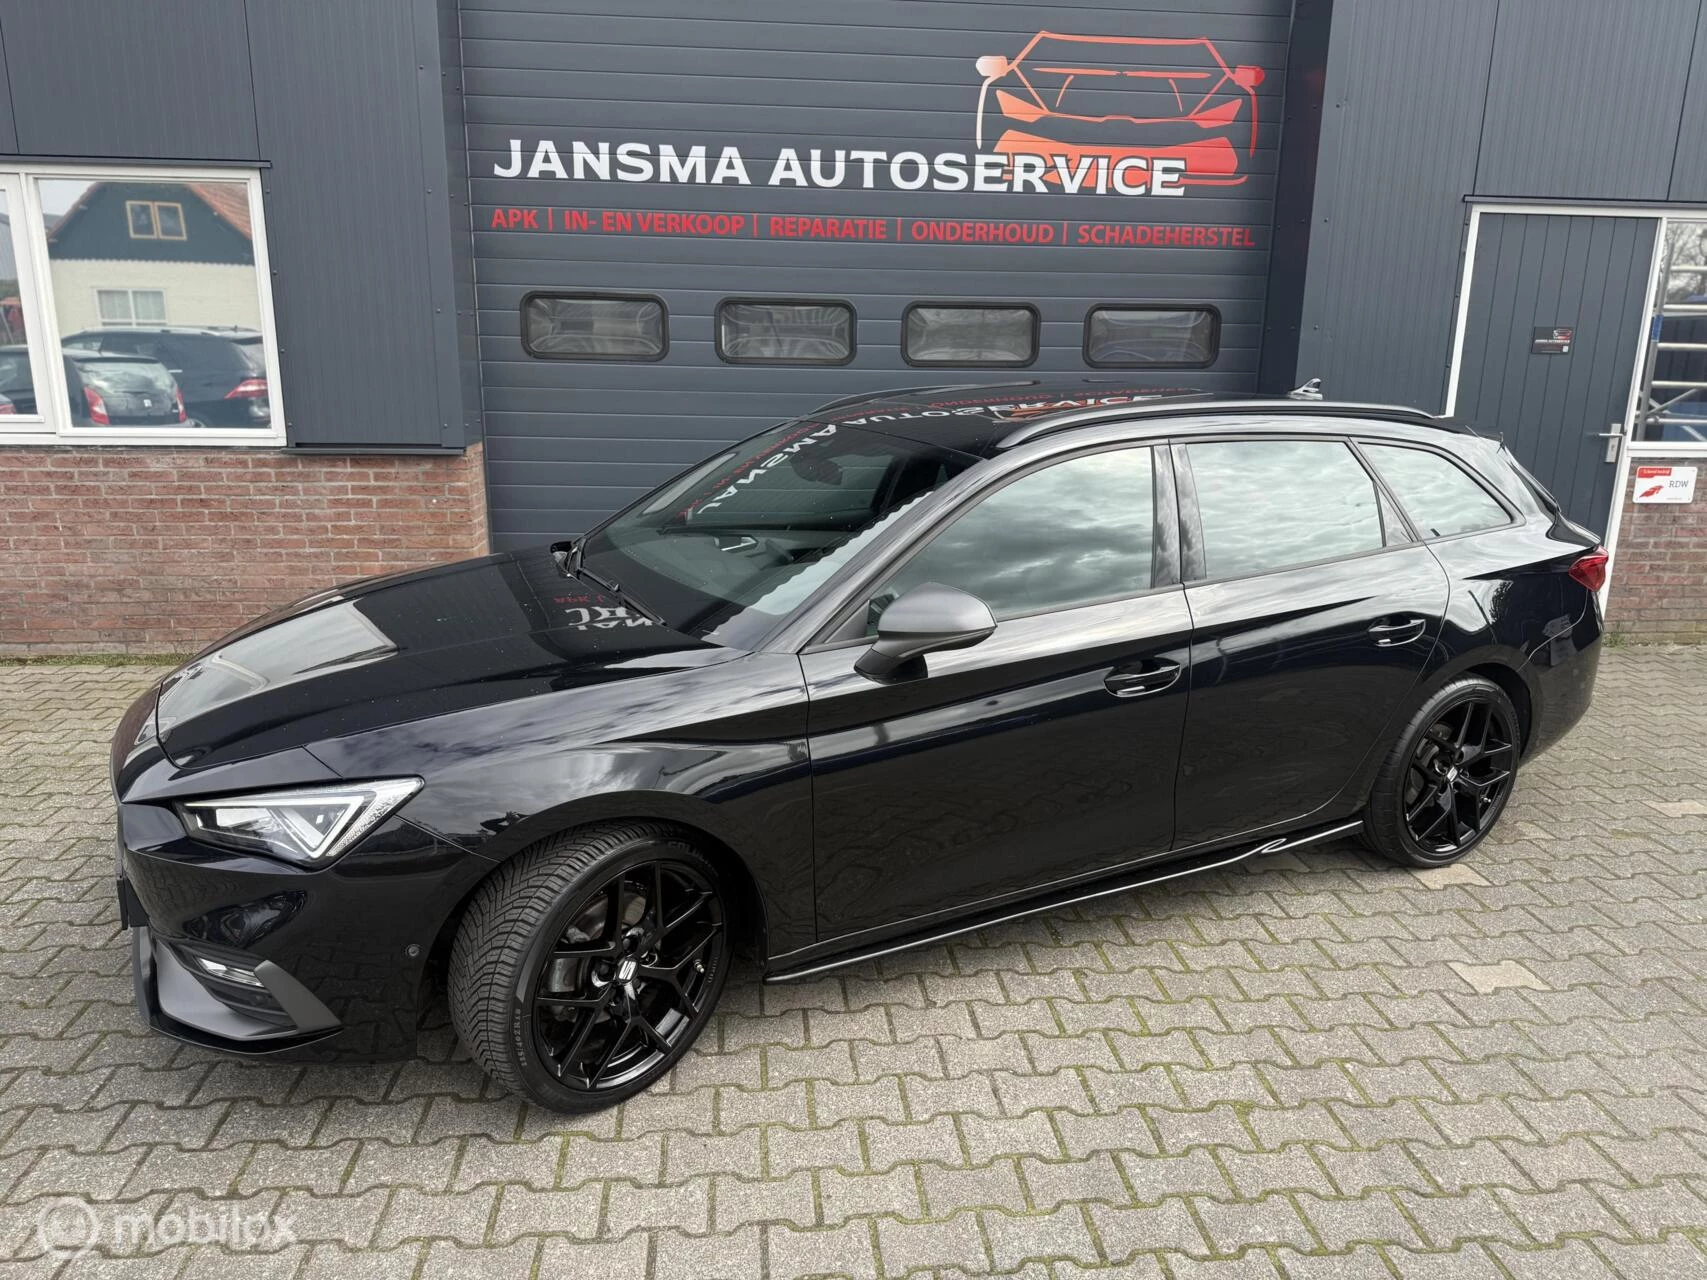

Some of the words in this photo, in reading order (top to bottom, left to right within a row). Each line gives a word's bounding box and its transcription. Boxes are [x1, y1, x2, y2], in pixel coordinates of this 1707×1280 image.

[493, 139, 752, 185] JANSMA
[768, 148, 1186, 196] AUTOSERVICE
[491, 208, 539, 229] APK
[564, 210, 596, 231] IN-
[602, 211, 632, 232] EN
[637, 212, 745, 235] VERKOOP
[769, 216, 887, 240] REPARATIE
[911, 220, 1055, 244] ONDERHOUD
[1078, 224, 1255, 247] SCHADEHERSTEL
[1668, 480, 1689, 489] RDW
